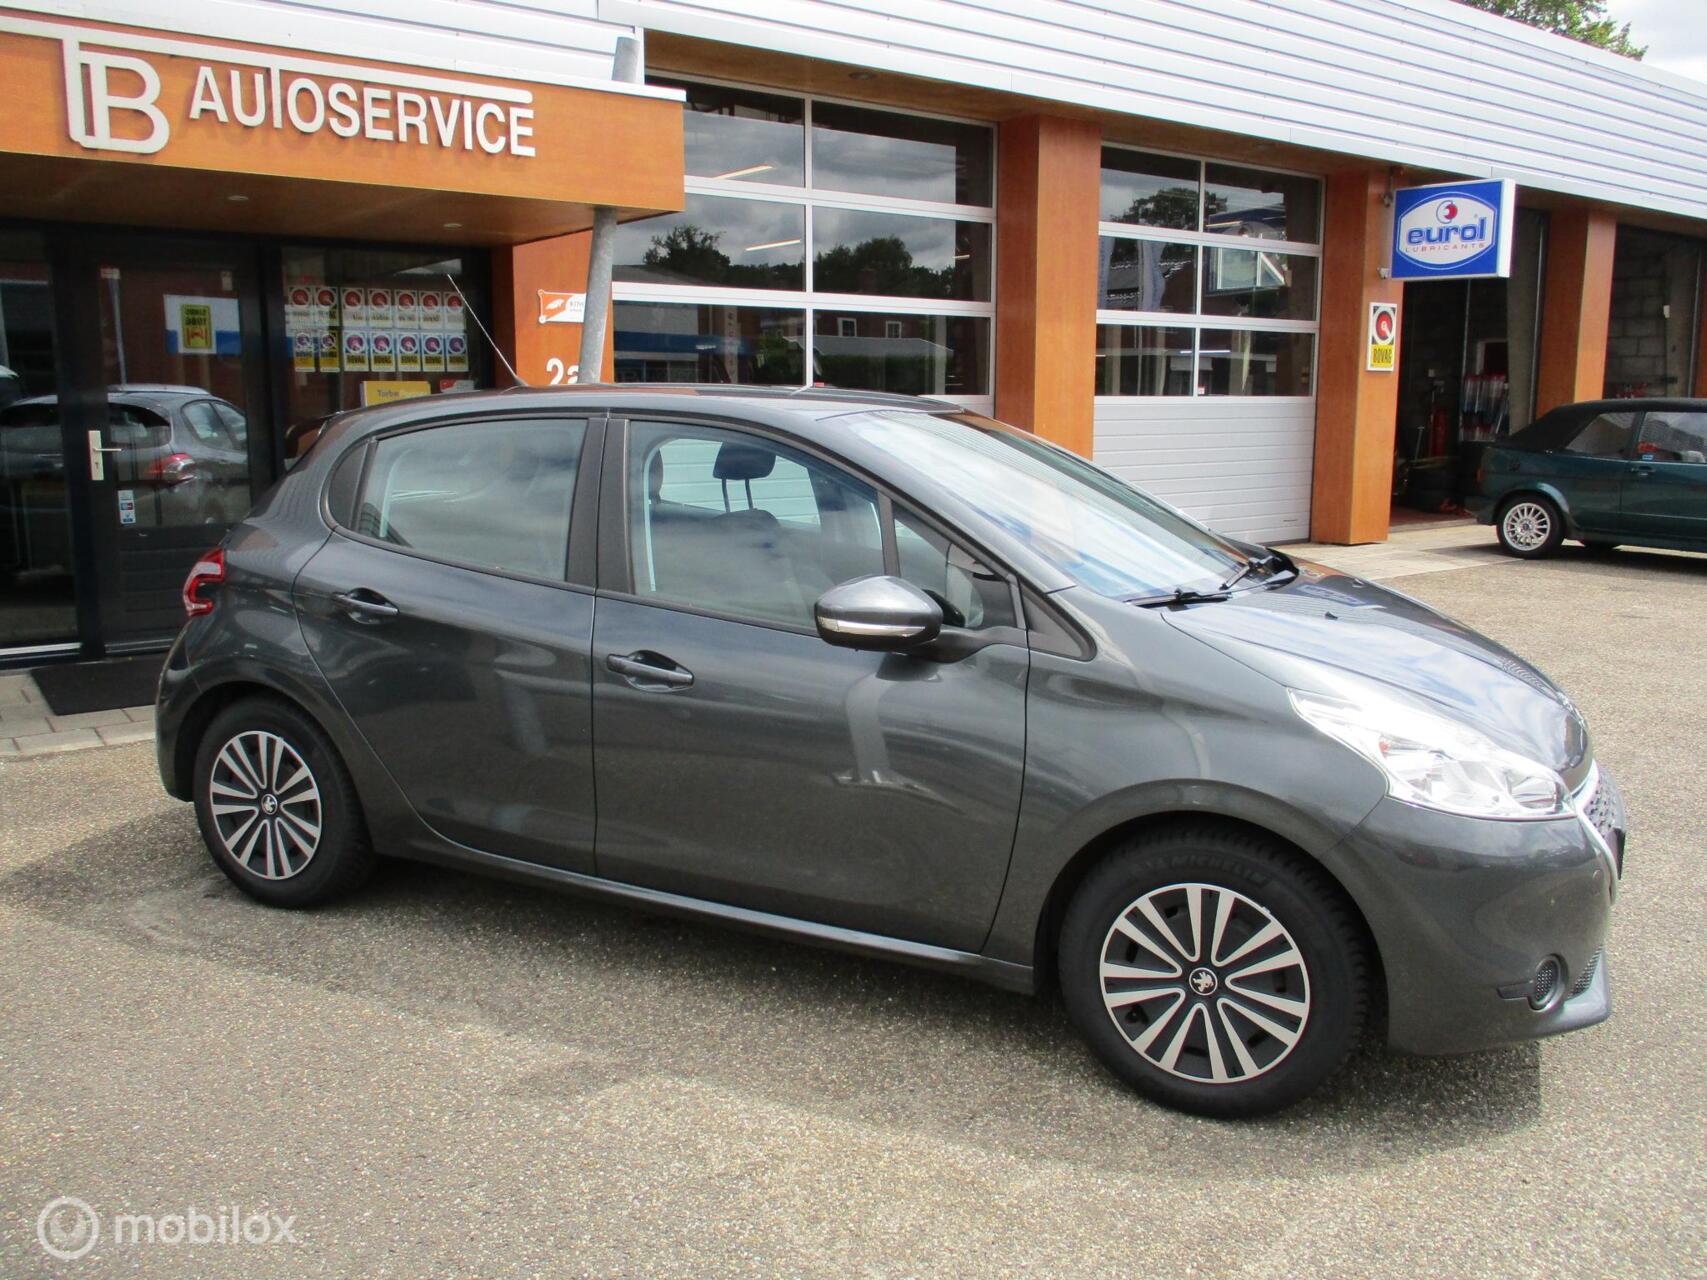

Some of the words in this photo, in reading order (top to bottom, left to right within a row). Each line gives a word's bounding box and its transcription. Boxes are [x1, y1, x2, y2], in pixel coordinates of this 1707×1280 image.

[189, 65, 536, 157] AUTOSERVICE
[1407, 216, 1487, 246] eurol
[1405, 242, 1486, 253] LUBRICANTS
[1373, 348, 1392, 364] BOVAG
